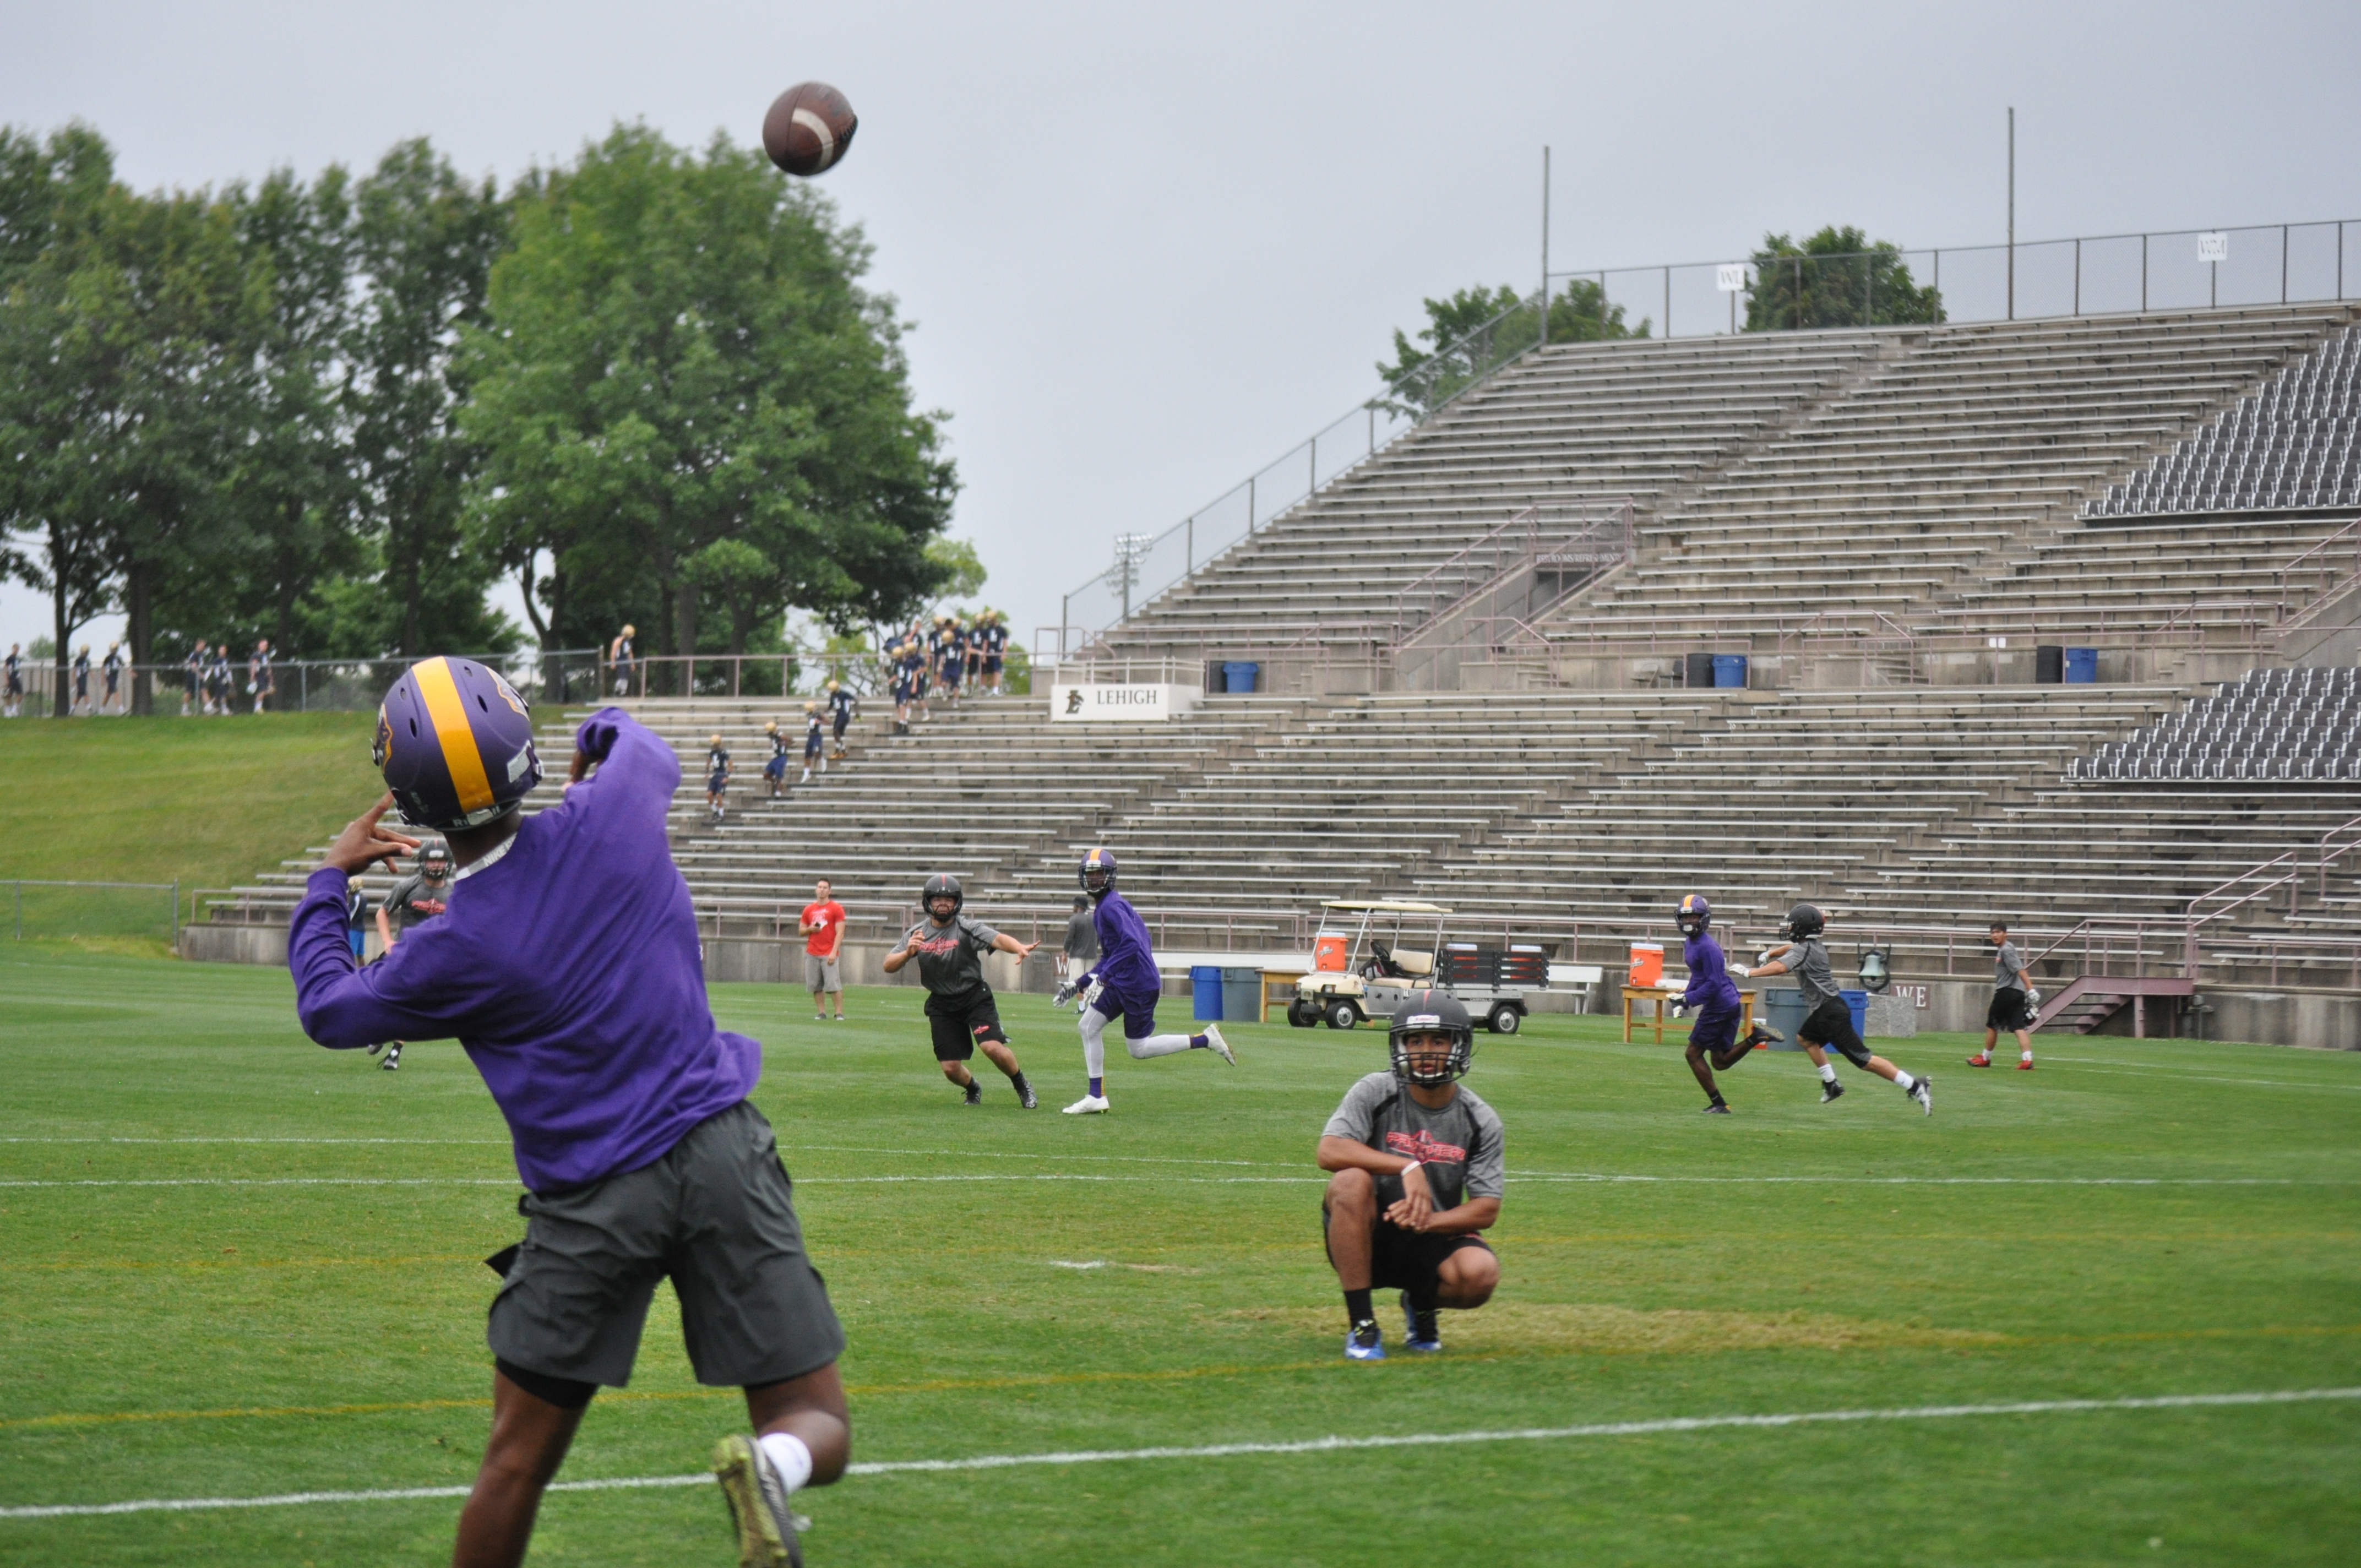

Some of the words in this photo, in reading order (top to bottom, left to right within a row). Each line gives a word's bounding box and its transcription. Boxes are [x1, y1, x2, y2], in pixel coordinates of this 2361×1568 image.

[1097, 690, 1157, 704] LEHIGH
[483, 846, 508, 867] NIKE
[1896, 986, 1927, 1007] WE
